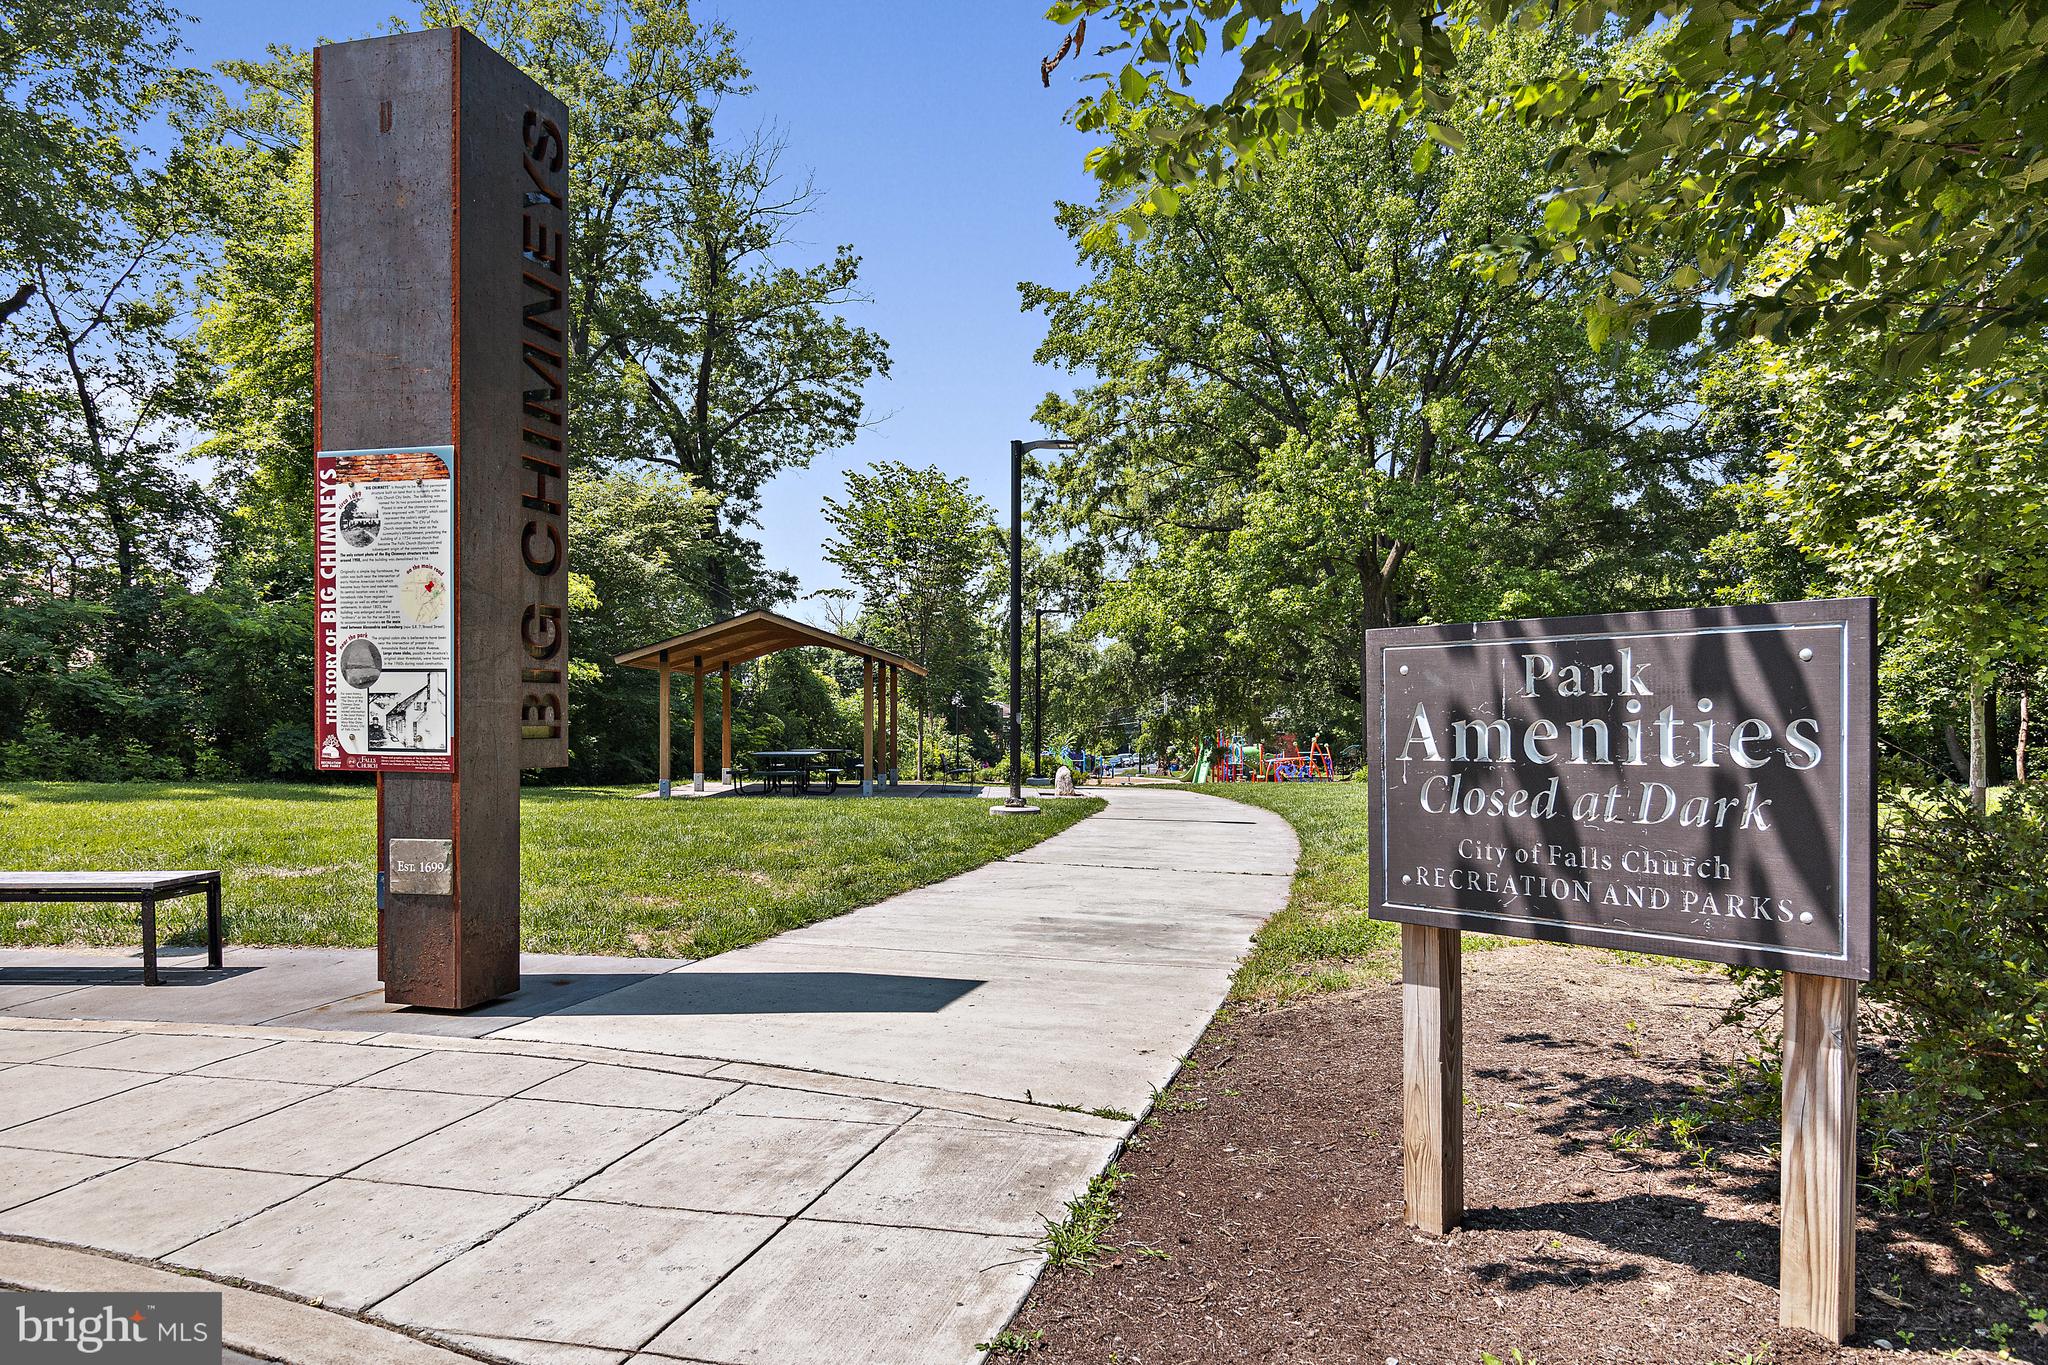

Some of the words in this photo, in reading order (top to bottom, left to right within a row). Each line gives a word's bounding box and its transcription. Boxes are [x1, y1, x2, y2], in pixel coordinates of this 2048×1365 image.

[522, 110, 564, 577] CHIMNEYS
[320, 468, 336, 579] CHIMNEYS
[320, 587, 336, 622] BIG
[326, 629, 336, 646] OF
[326, 652, 336, 696] STORY
[521, 603, 562, 740] BIG
[1521, 647, 1653, 699] Park
[326, 699, 336, 724] THE
[1395, 698, 1822, 771] Amenities
[1420, 774, 1558, 818] Closed
[1571, 785, 1621, 823] at
[1632, 781, 1774, 832] Dark
[420, 862, 444, 872] 1699
[1458, 838, 1508, 867] City
[1515, 842, 1544, 865] of
[1548, 845, 1611, 871] Falls
[1621, 850, 1731, 881] Church
[1415, 866, 1593, 904] RECREATION
[1603, 884, 1670, 912] AND
[1681, 889, 1793, 923] PARKS
